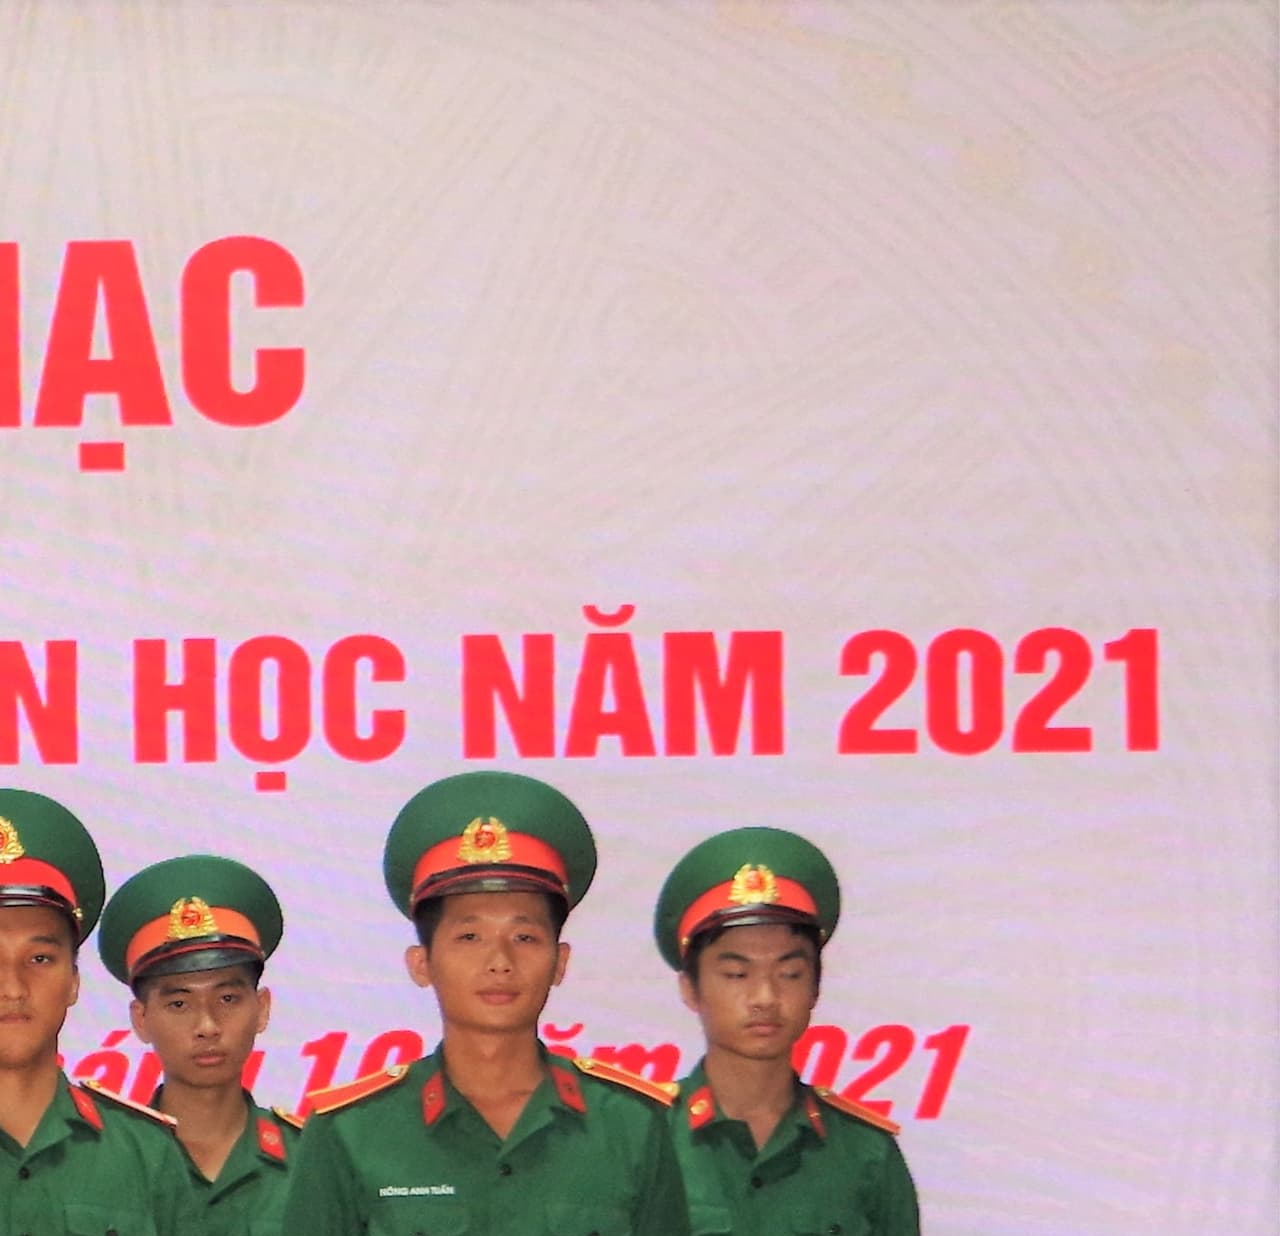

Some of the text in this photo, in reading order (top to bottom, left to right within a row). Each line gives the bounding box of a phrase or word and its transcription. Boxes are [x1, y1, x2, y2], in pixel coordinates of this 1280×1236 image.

[133, 634, 407, 792] HỌC
[462, 604, 786, 760] NĂM
[837, 627, 1161, 757] 2021
[792, 1024, 971, 1120] 021
